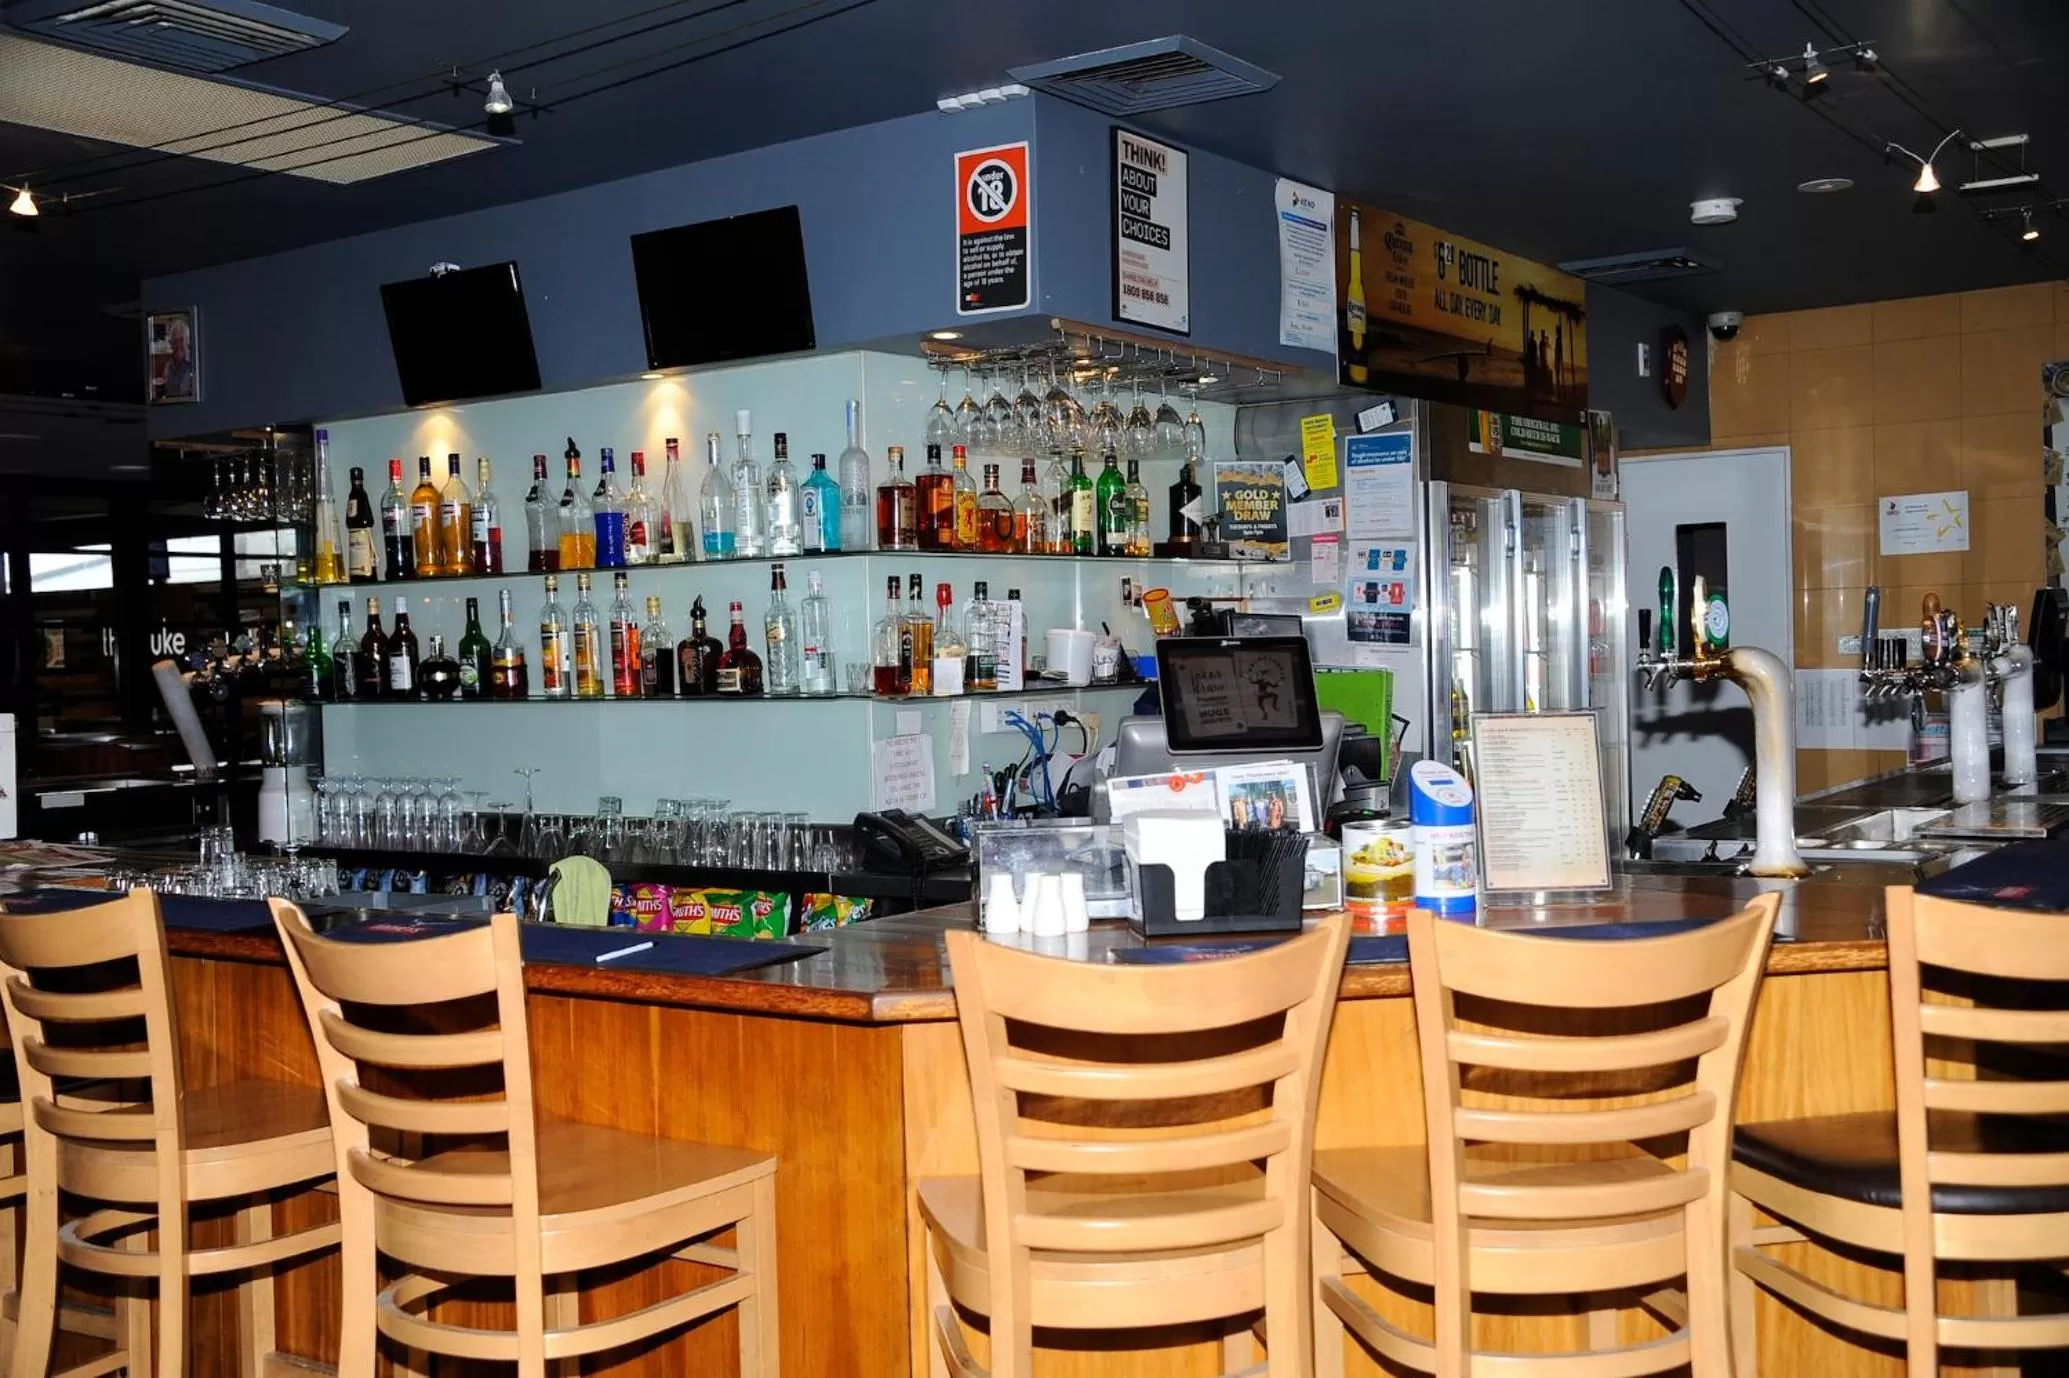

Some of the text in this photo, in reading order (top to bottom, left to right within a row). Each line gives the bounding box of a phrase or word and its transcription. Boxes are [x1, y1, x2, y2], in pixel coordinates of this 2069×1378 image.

[1122, 140, 1166, 173] THINK!
[1123, 168, 1155, 193] ABOUT
[977, 181, 1004, 212] 18
[1122, 193, 1149, 216] YOUR
[1122, 218, 1168, 245] CHOICES
[1459, 249, 1501, 297] BOTTLE
[1435, 287, 1449, 312] ALL
[1465, 297, 1487, 322] EVERY
[1488, 303, 1502, 327] DAY
[1225, 499, 1279, 511] MEMBER
[1234, 489, 1269, 500] GOLD
[1233, 510, 1272, 521] DRAW
[150, 626, 186, 656] uke
